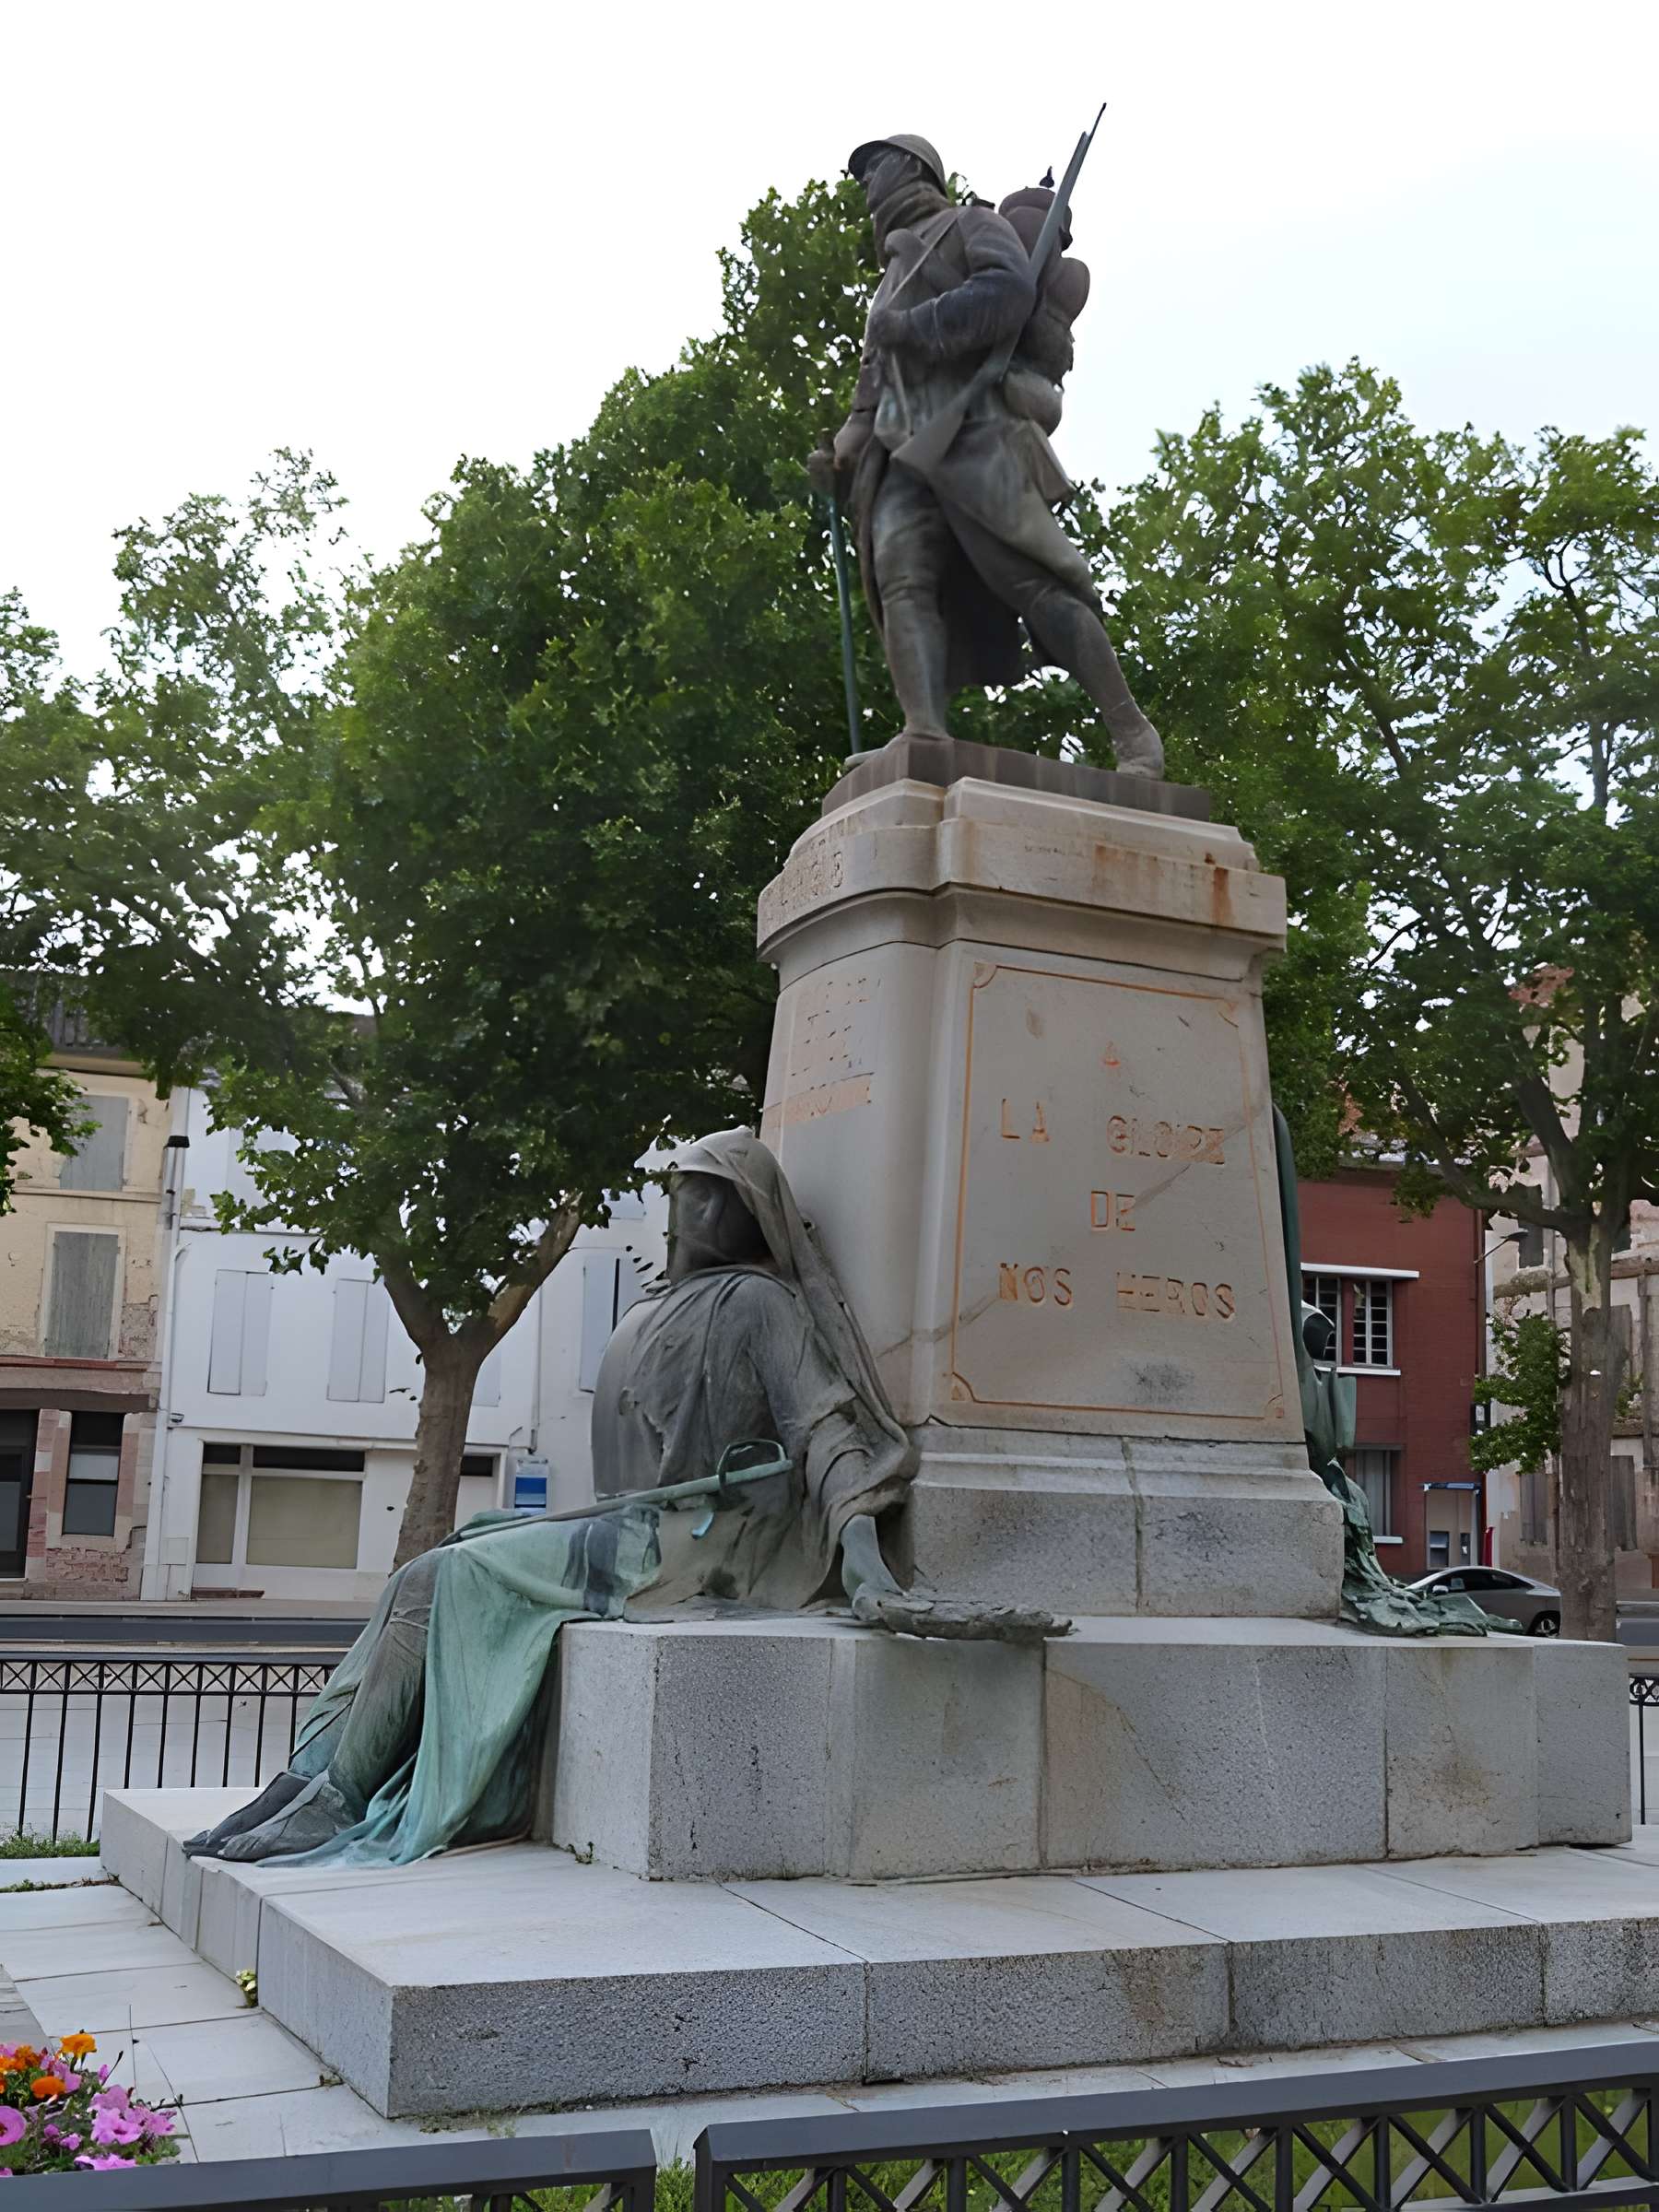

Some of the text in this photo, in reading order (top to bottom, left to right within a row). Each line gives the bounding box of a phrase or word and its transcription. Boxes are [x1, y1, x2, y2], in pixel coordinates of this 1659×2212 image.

[1002, 1098, 1225, 1165] LA GLORE
[1090, 1190, 1136, 1231] DE
[999, 1262, 1073, 1307] NOS
